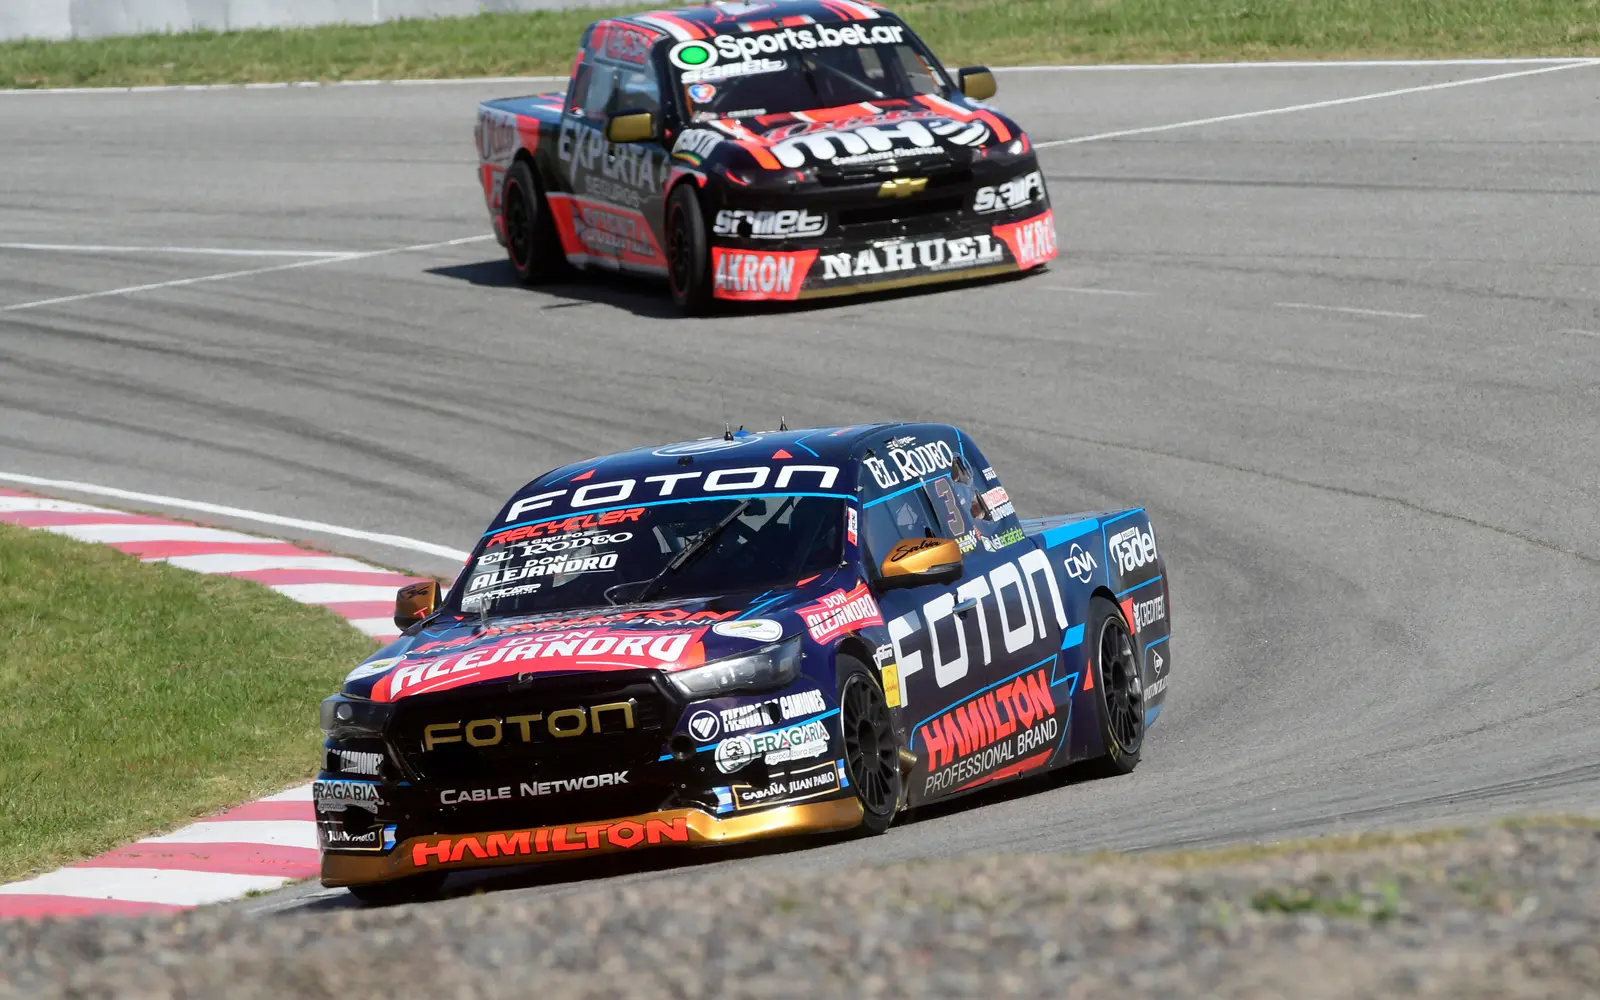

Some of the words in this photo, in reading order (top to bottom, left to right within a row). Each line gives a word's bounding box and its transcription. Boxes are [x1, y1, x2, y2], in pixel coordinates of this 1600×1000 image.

[714, 24, 903, 60] Sports.bet.ar
[559, 118, 656, 194] EXPERTA
[715, 252, 795, 294] AKRON
[820, 233, 1004, 279] NAHUEL
[863, 457, 900, 489] EL
[888, 440, 954, 481] RODEO
[505, 465, 840, 522] FOTON
[934, 477, 965, 537] 3
[486, 507, 646, 548] RECYCLER
[531, 532, 583, 545] GRUPO
[478, 551, 515, 567] EL
[520, 532, 634, 557] RODEO
[525, 554, 568, 567] DON
[1109, 522, 1158, 576] Fadel
[470, 554, 619, 591] ALEJANDRO
[807, 594, 879, 639] ALEJANDRO
[825, 592, 848, 608] DON
[505, 629, 590, 647] DON
[888, 549, 1069, 708] FOTON
[390, 634, 692, 700] ALEJANDRO
[424, 699, 636, 751] FOTON
[720, 703, 761, 732] TIENDA
[780, 689, 826, 720] CAMIONES
[920, 669, 1056, 772] HAMILTON
[753, 720, 830, 753] FRAGARIA
[923, 741, 1016, 797] PROFESSIONAL
[1017, 717, 1058, 756] BRAND
[313, 781, 379, 801] FRAGARIA
[440, 786, 511, 805] CABLE
[519, 770, 629, 797] NETWORK
[742, 782, 787, 801] CABAÑA
[789, 777, 813, 794] JUAN
[813, 771, 836, 787] PABLO
[328, 830, 351, 842] JUAN
[412, 818, 690, 867] HAMILTON
